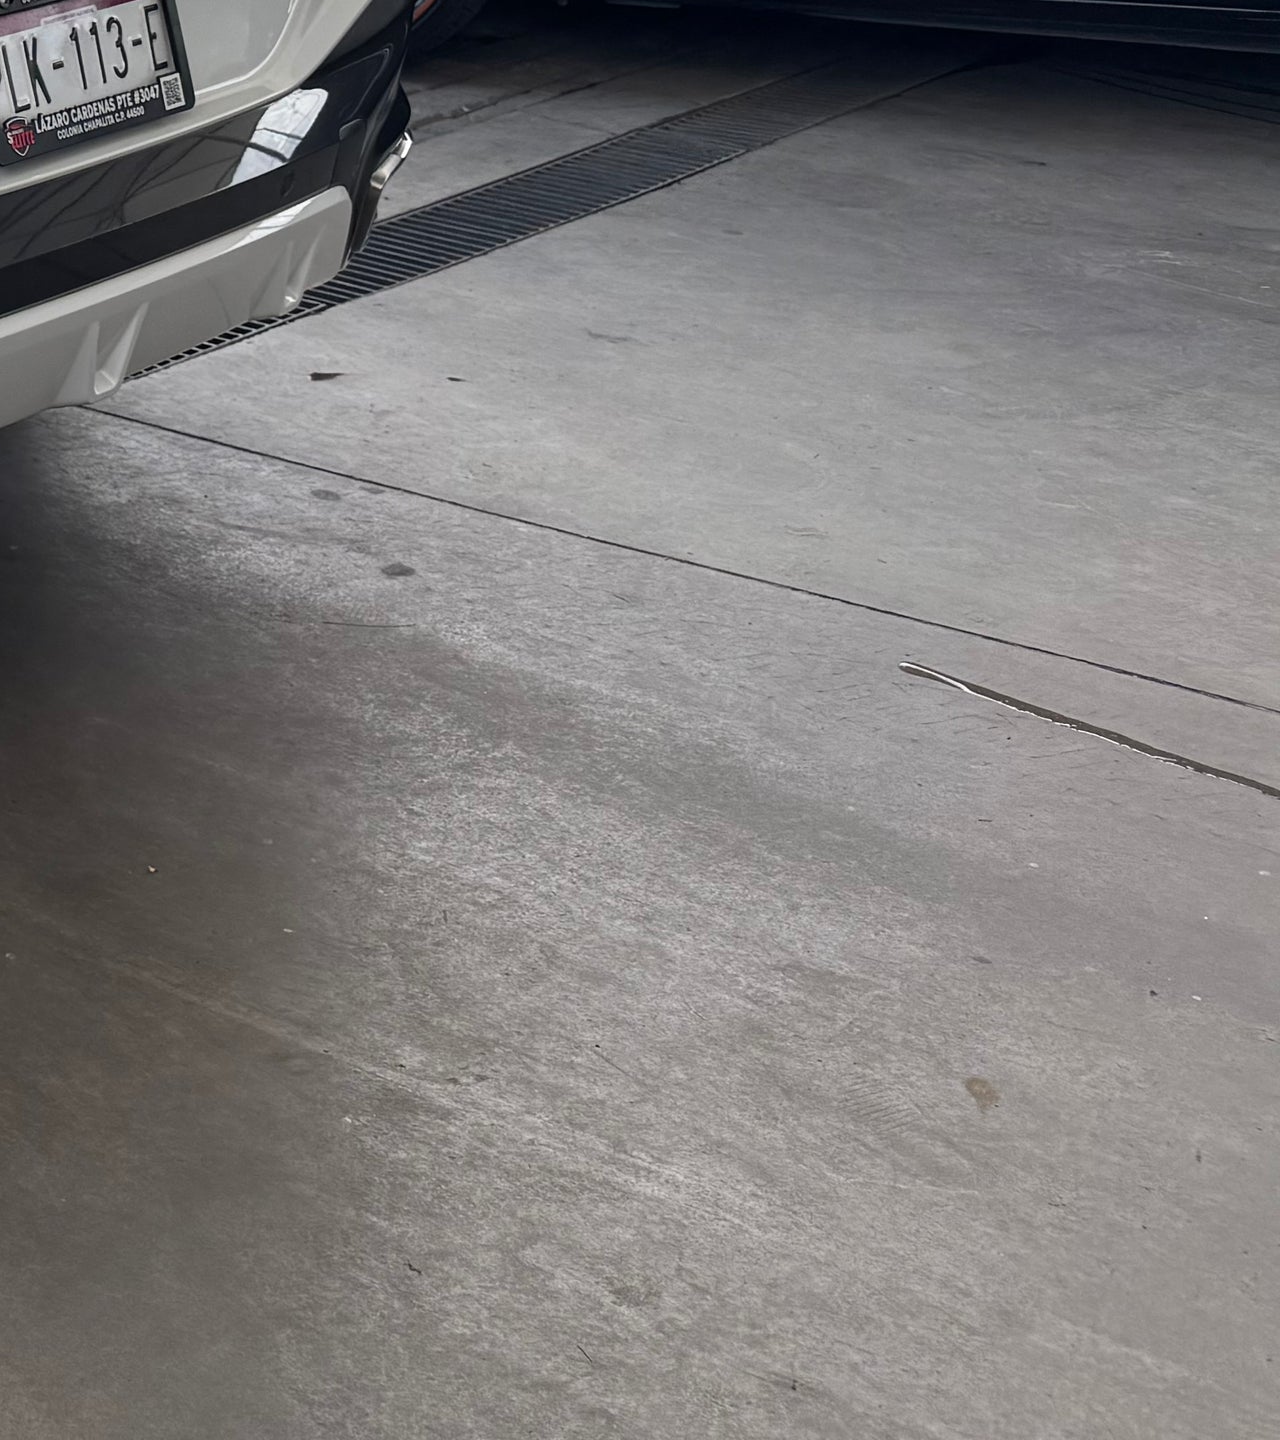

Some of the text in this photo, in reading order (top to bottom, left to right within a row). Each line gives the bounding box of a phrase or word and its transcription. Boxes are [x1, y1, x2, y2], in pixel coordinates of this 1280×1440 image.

[72, 97, 116, 123] CARDENAS
[117, 93, 134, 110] PTE
[57, 123, 83, 140] COLONIA
